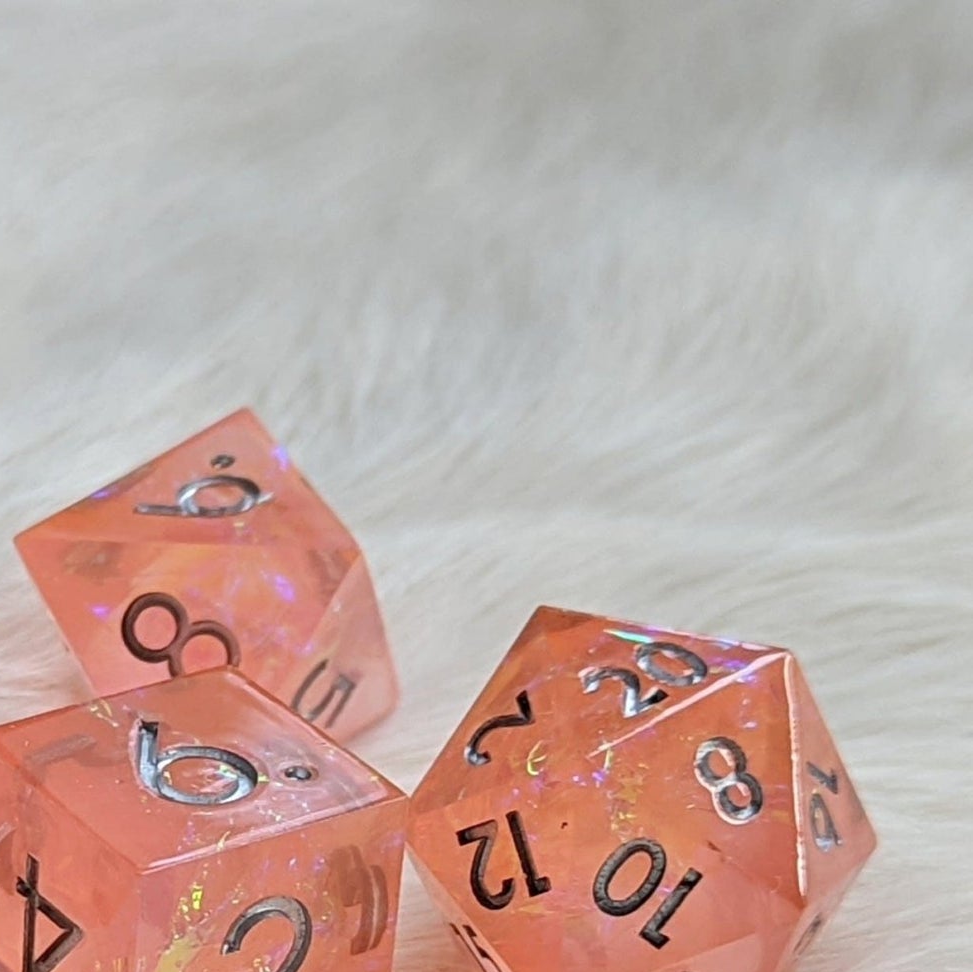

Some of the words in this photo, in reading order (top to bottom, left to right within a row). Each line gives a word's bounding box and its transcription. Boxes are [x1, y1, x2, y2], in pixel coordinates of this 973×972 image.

[121, 592, 240, 679] 8
[581, 641, 708, 718] 20
[694, 736, 763, 825] 8
[456, 810, 552, 911] 12
[593, 837, 702, 949] 10
